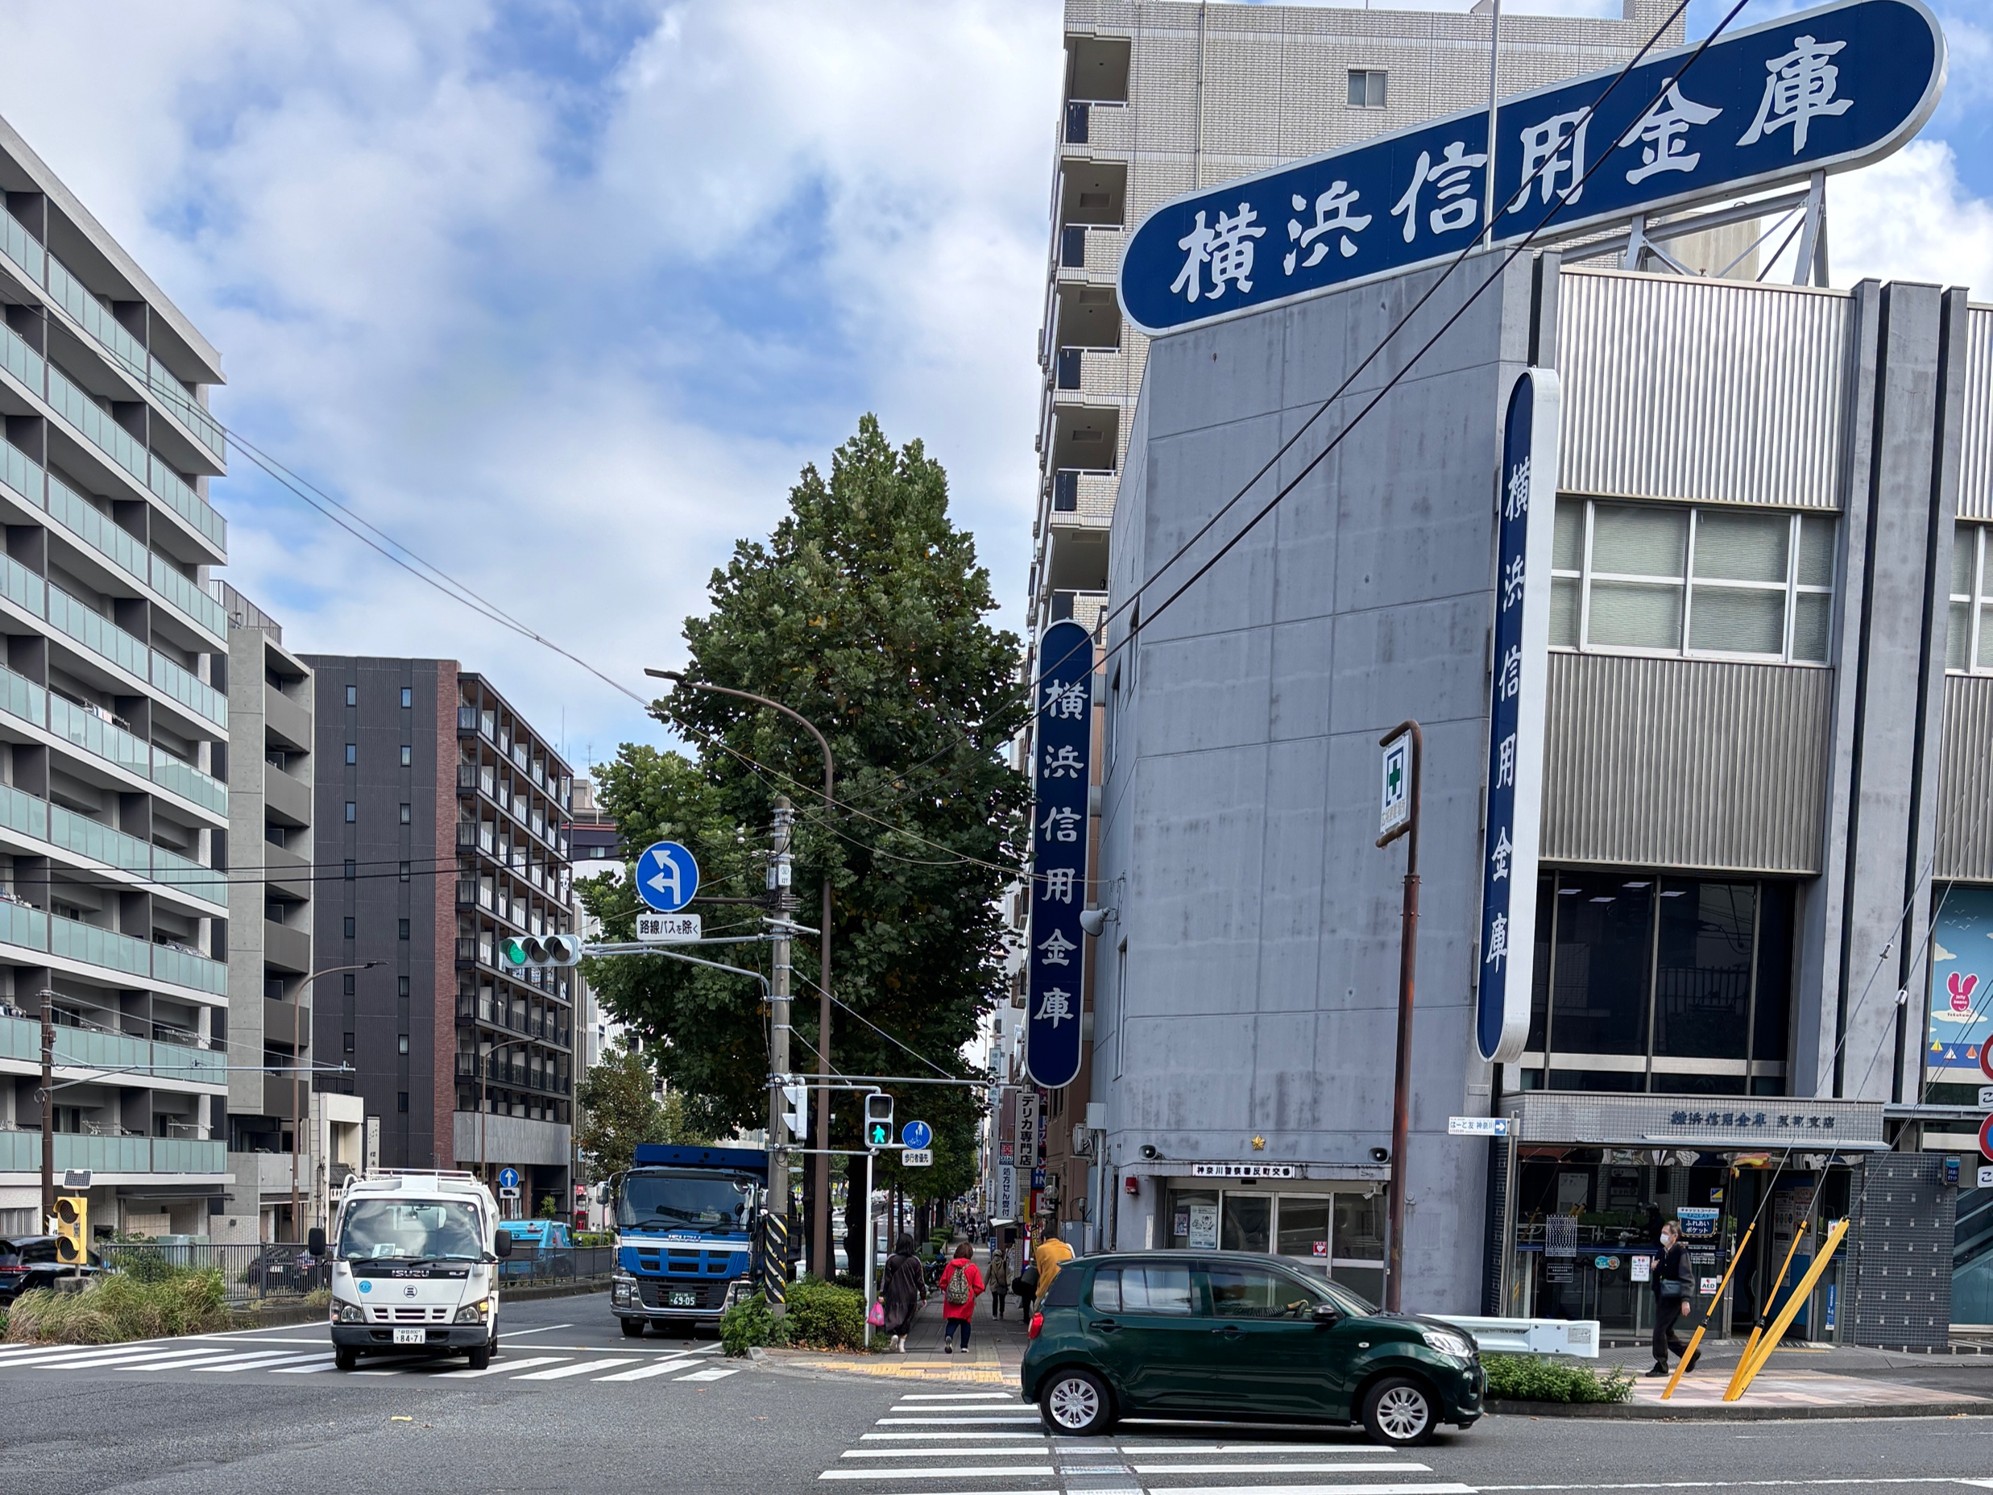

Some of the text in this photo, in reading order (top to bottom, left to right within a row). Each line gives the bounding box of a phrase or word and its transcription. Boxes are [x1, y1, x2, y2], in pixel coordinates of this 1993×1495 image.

[1169, 35, 1855, 304] 横浜信用金庫
[1484, 455, 1531, 974] 横浜信用金庫
[1033, 677, 1088, 1030] 横浜信用金庫
[640, 919, 699, 935] 路線バスを除く
[1020, 1095, 1035, 1166] デリカ専門店
[904, 1153, 929, 1164] 歩行者優先
[1196, 1165, 1290, 1176] 神奈川警察署反町交番
[1002, 1167, 1011, 1217] 処方せん受付
[1685, 1219, 1710, 1227] ふれあい
[1685, 1226, 1709, 1234] ポケット
[667, 1234, 702, 1243] ISUZU
[391, 1269, 430, 1278] ISUZU
[673, 1296, 696, 1306] 69-05
[400, 1334, 423, 1343] 84-71
